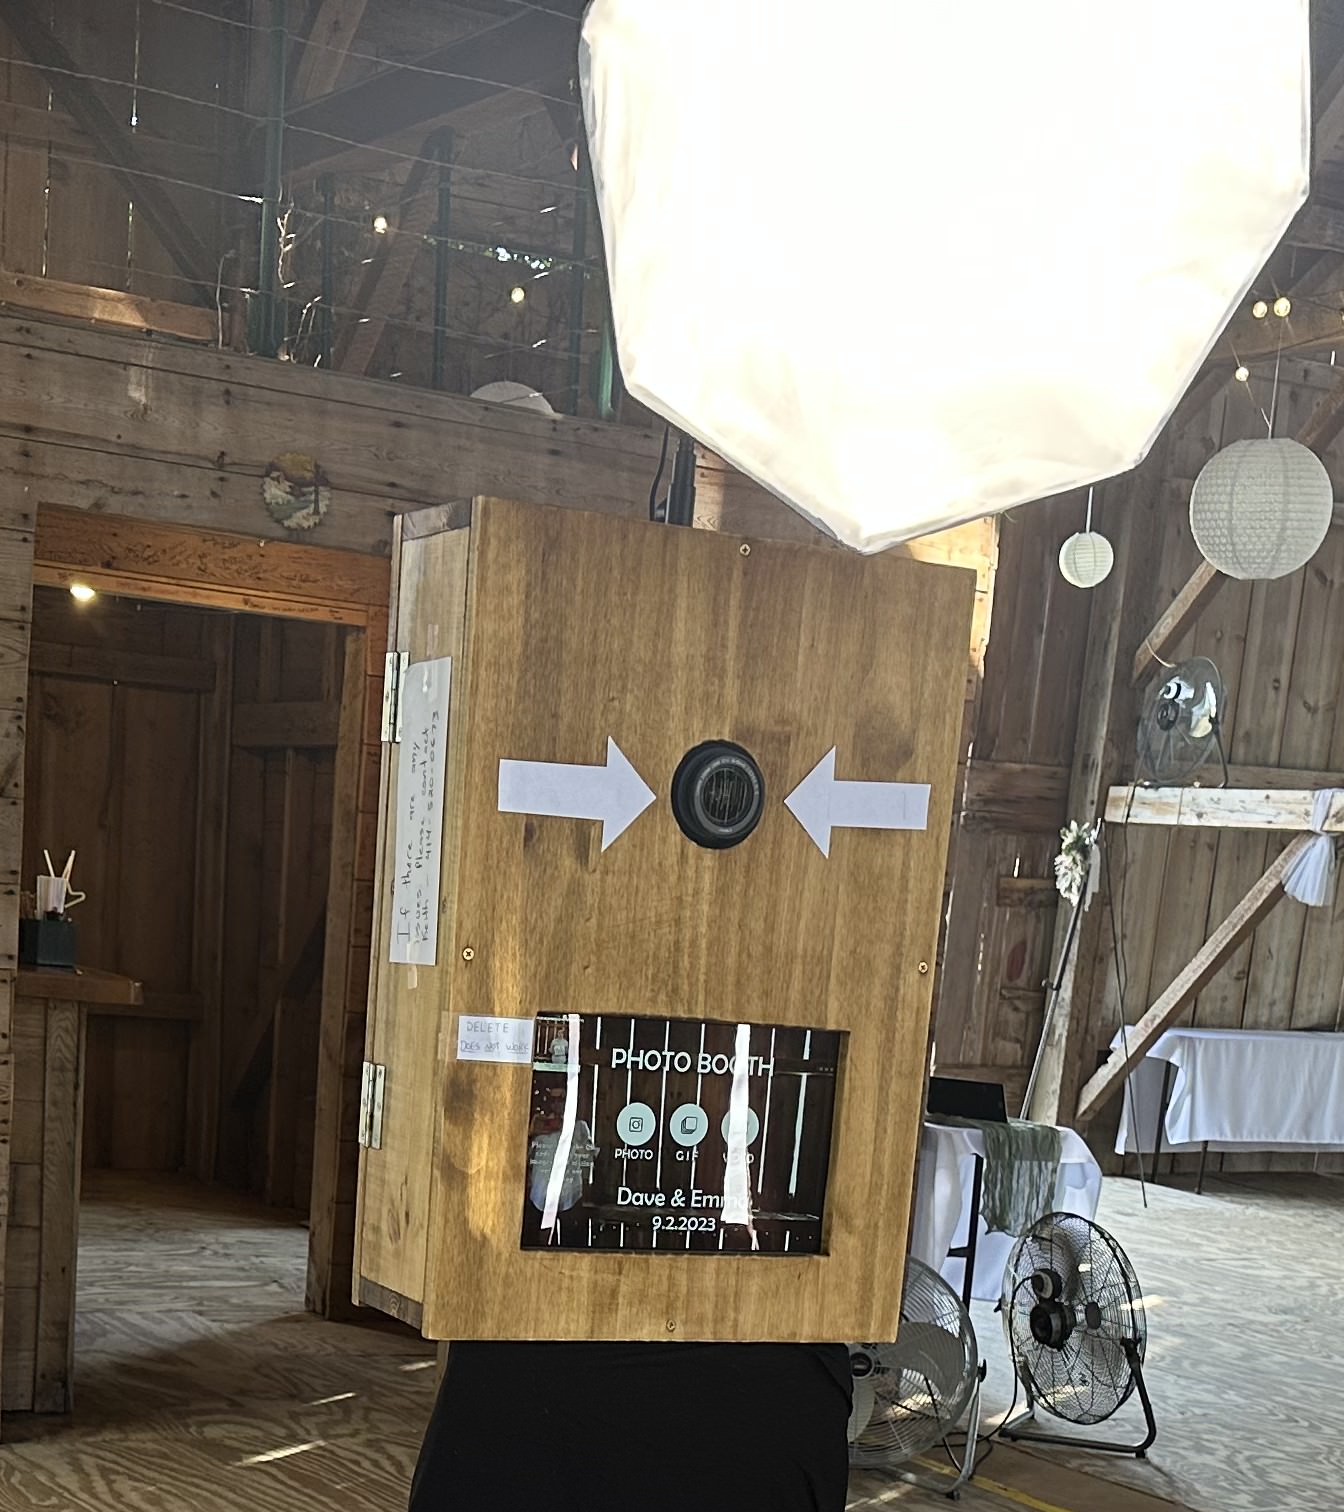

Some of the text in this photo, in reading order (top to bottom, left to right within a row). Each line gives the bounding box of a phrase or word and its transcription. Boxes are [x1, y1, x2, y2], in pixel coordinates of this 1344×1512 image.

[411, 742, 421, 774] any
[400, 840, 413, 886] there
[397, 905, 411, 945] If
[466, 1021, 509, 1034] DELETE
[611, 1047, 692, 1073] PHOTO
[614, 1148, 654, 1161] PHOTO
[675, 1149, 699, 1162] GIF
[617, 1186, 666, 1207] Dave
[670, 1188, 686, 1208] &
[652, 1215, 717, 1232] 9.2.2023
